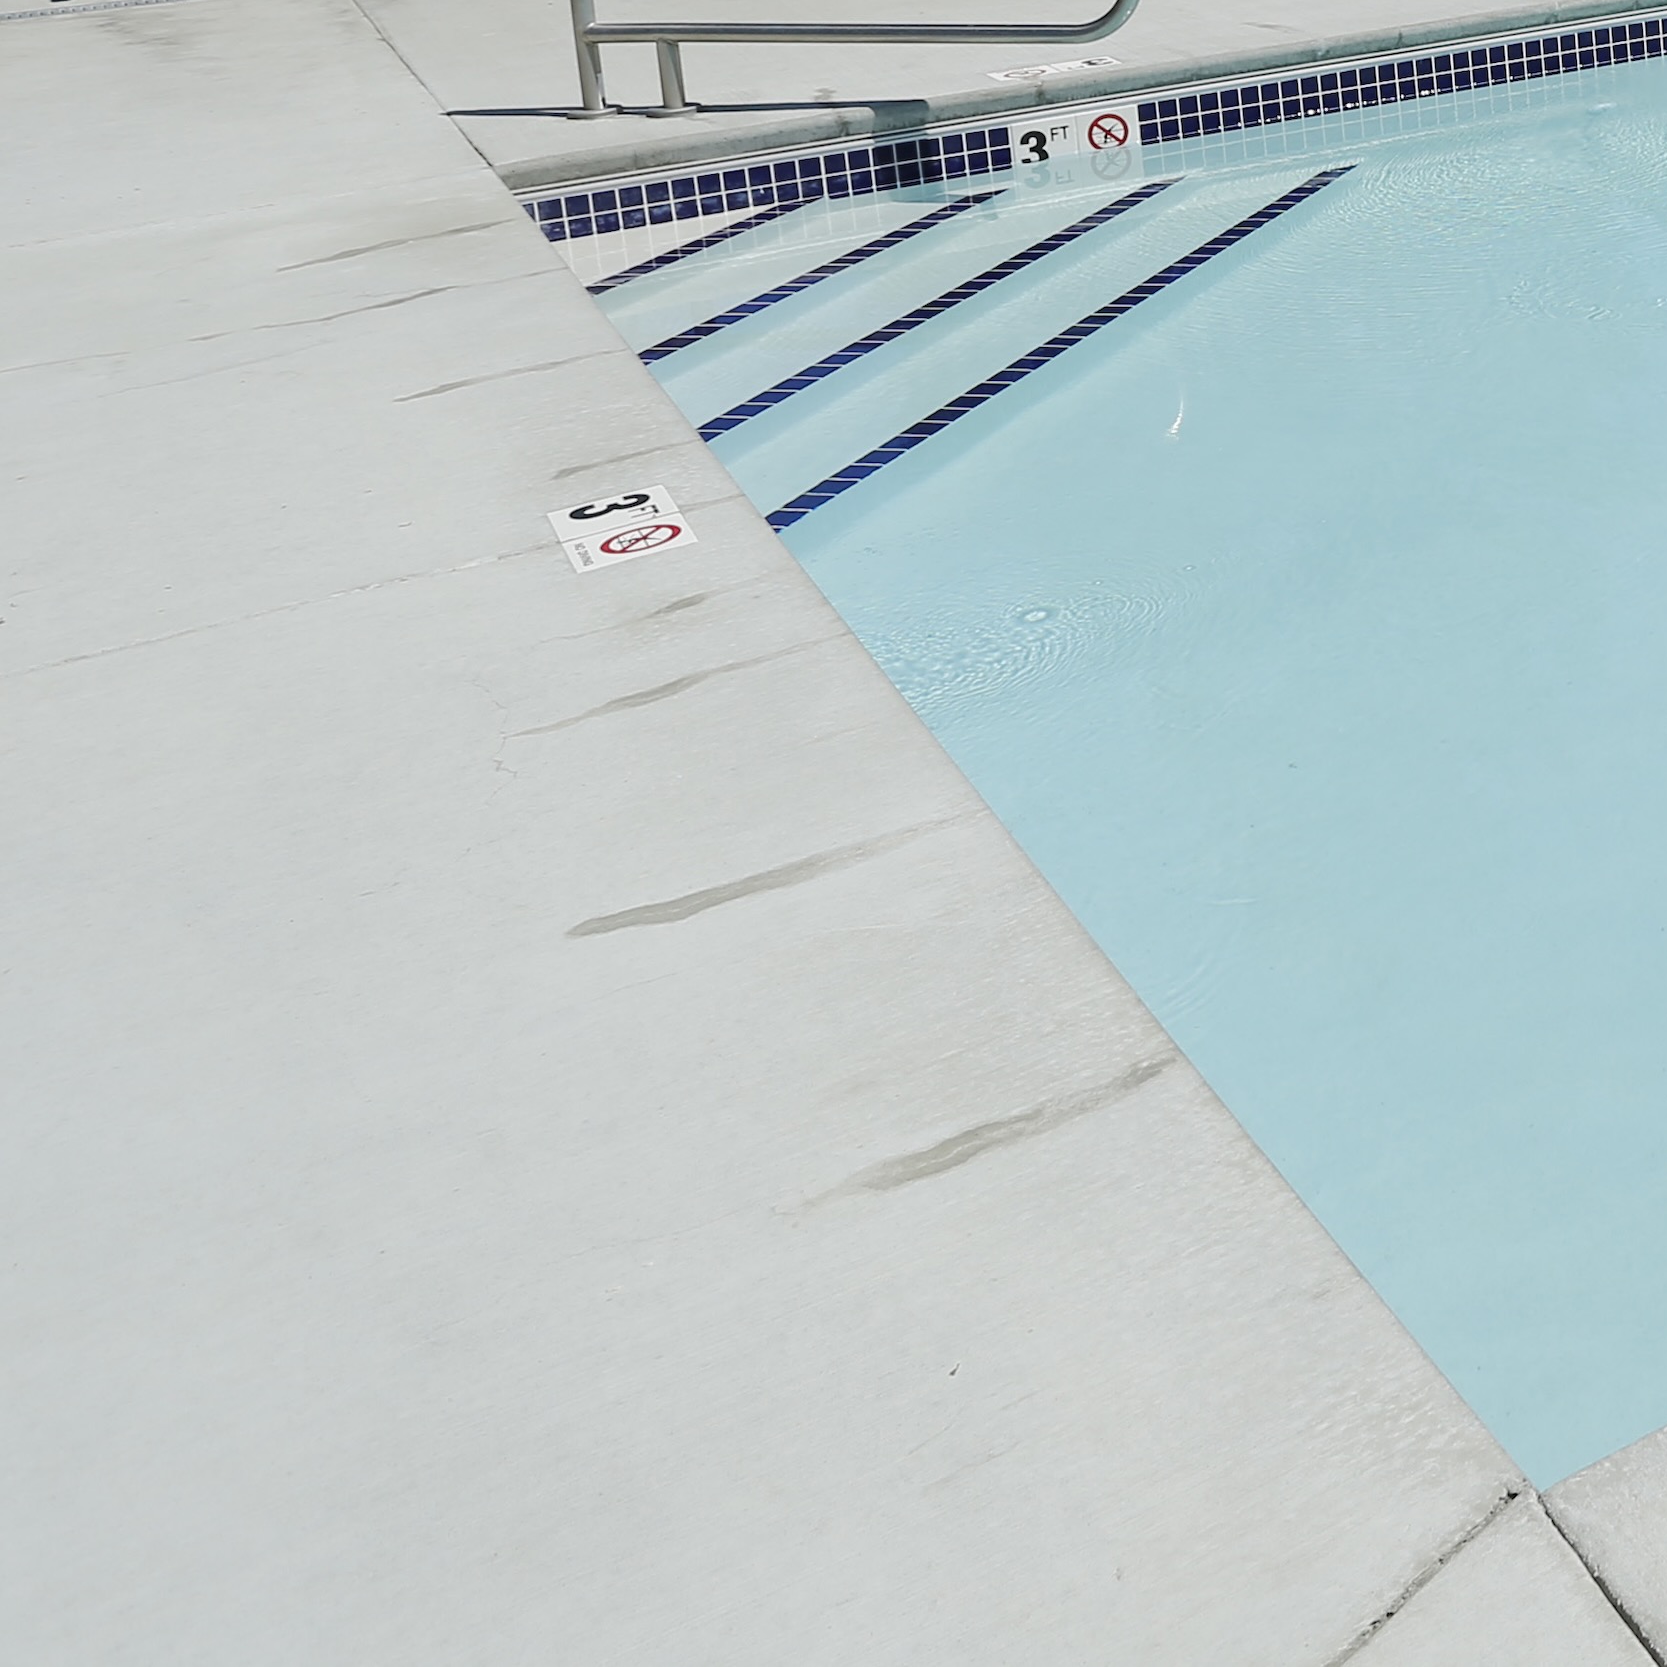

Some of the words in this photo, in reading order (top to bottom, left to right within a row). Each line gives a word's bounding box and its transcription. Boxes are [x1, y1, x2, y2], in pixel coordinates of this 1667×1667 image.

[1020, 130, 1049, 164] 3
[1050, 125, 1070, 142] FT
[569, 493, 651, 520] 3
[628, 504, 660, 519] FT
